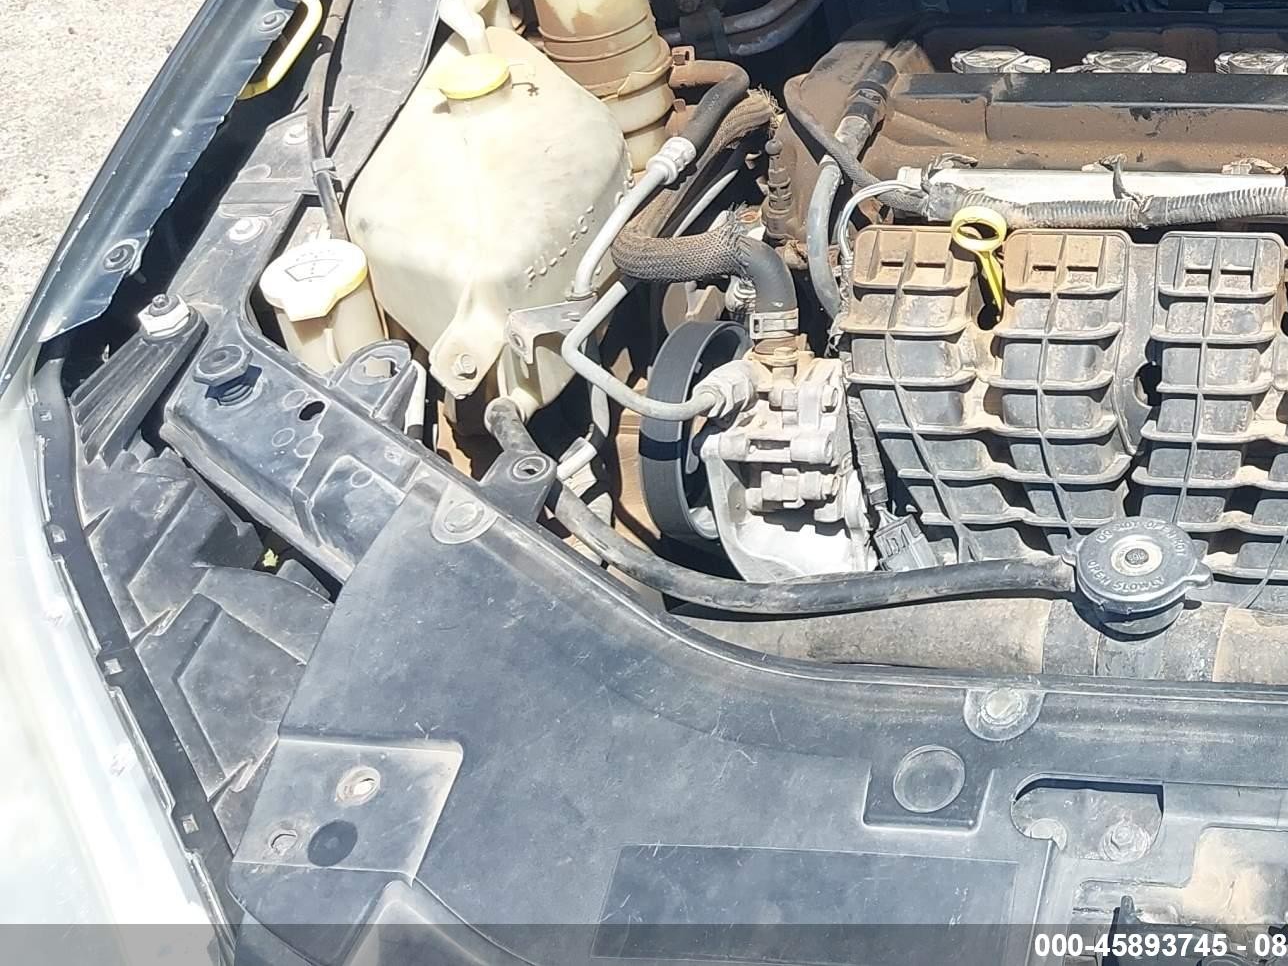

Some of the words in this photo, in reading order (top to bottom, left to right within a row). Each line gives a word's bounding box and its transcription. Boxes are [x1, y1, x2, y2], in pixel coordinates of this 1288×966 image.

[1095, 528, 1113, 544] DO
[1143, 520, 1177, 539] OPEN
[1086, 559, 1112, 586] OPEN
[1112, 575, 1165, 593] SLOWLY
